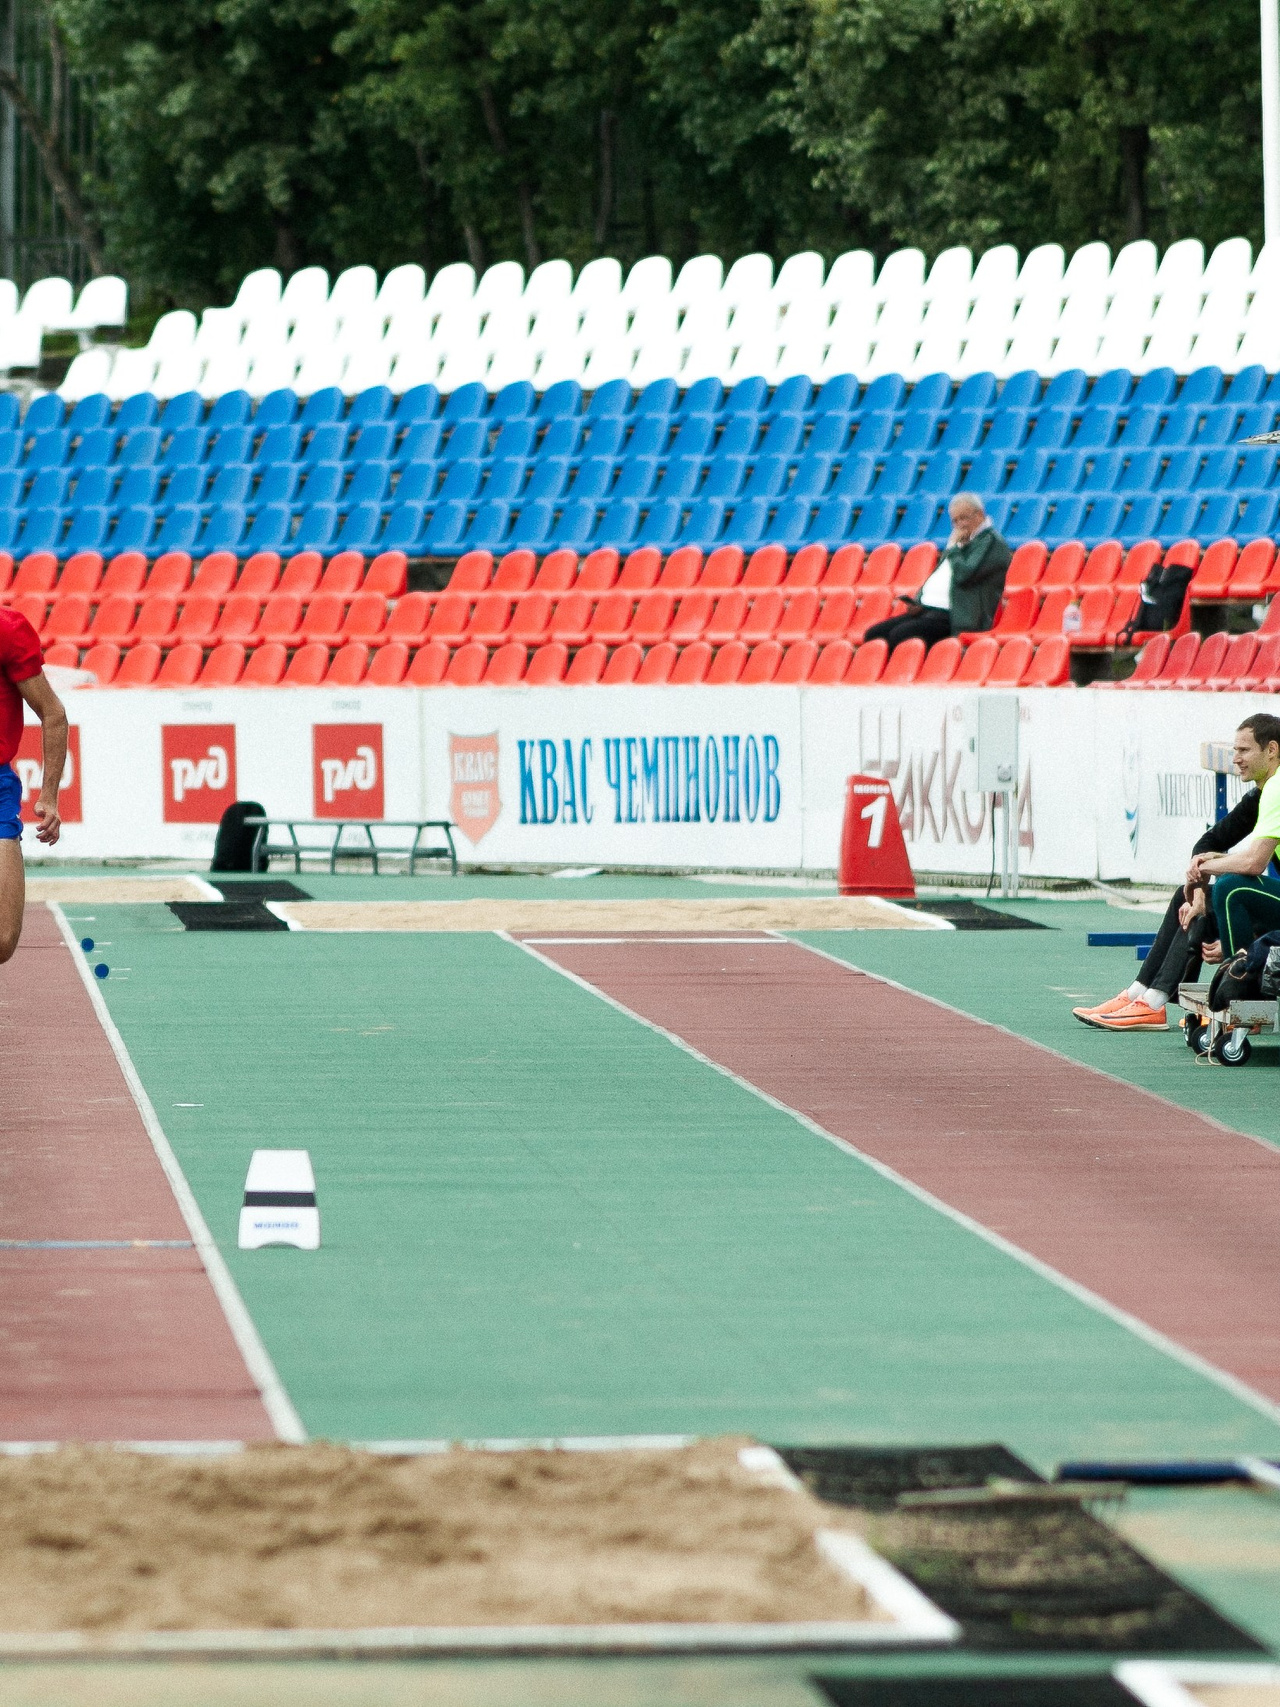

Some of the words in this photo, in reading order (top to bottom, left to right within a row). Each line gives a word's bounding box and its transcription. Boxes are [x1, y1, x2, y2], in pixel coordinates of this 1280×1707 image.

[517, 738, 594, 825] КВАС
[602, 735, 782, 824] ЧЕМПИОНОВ
[861, 795, 887, 848] 1
